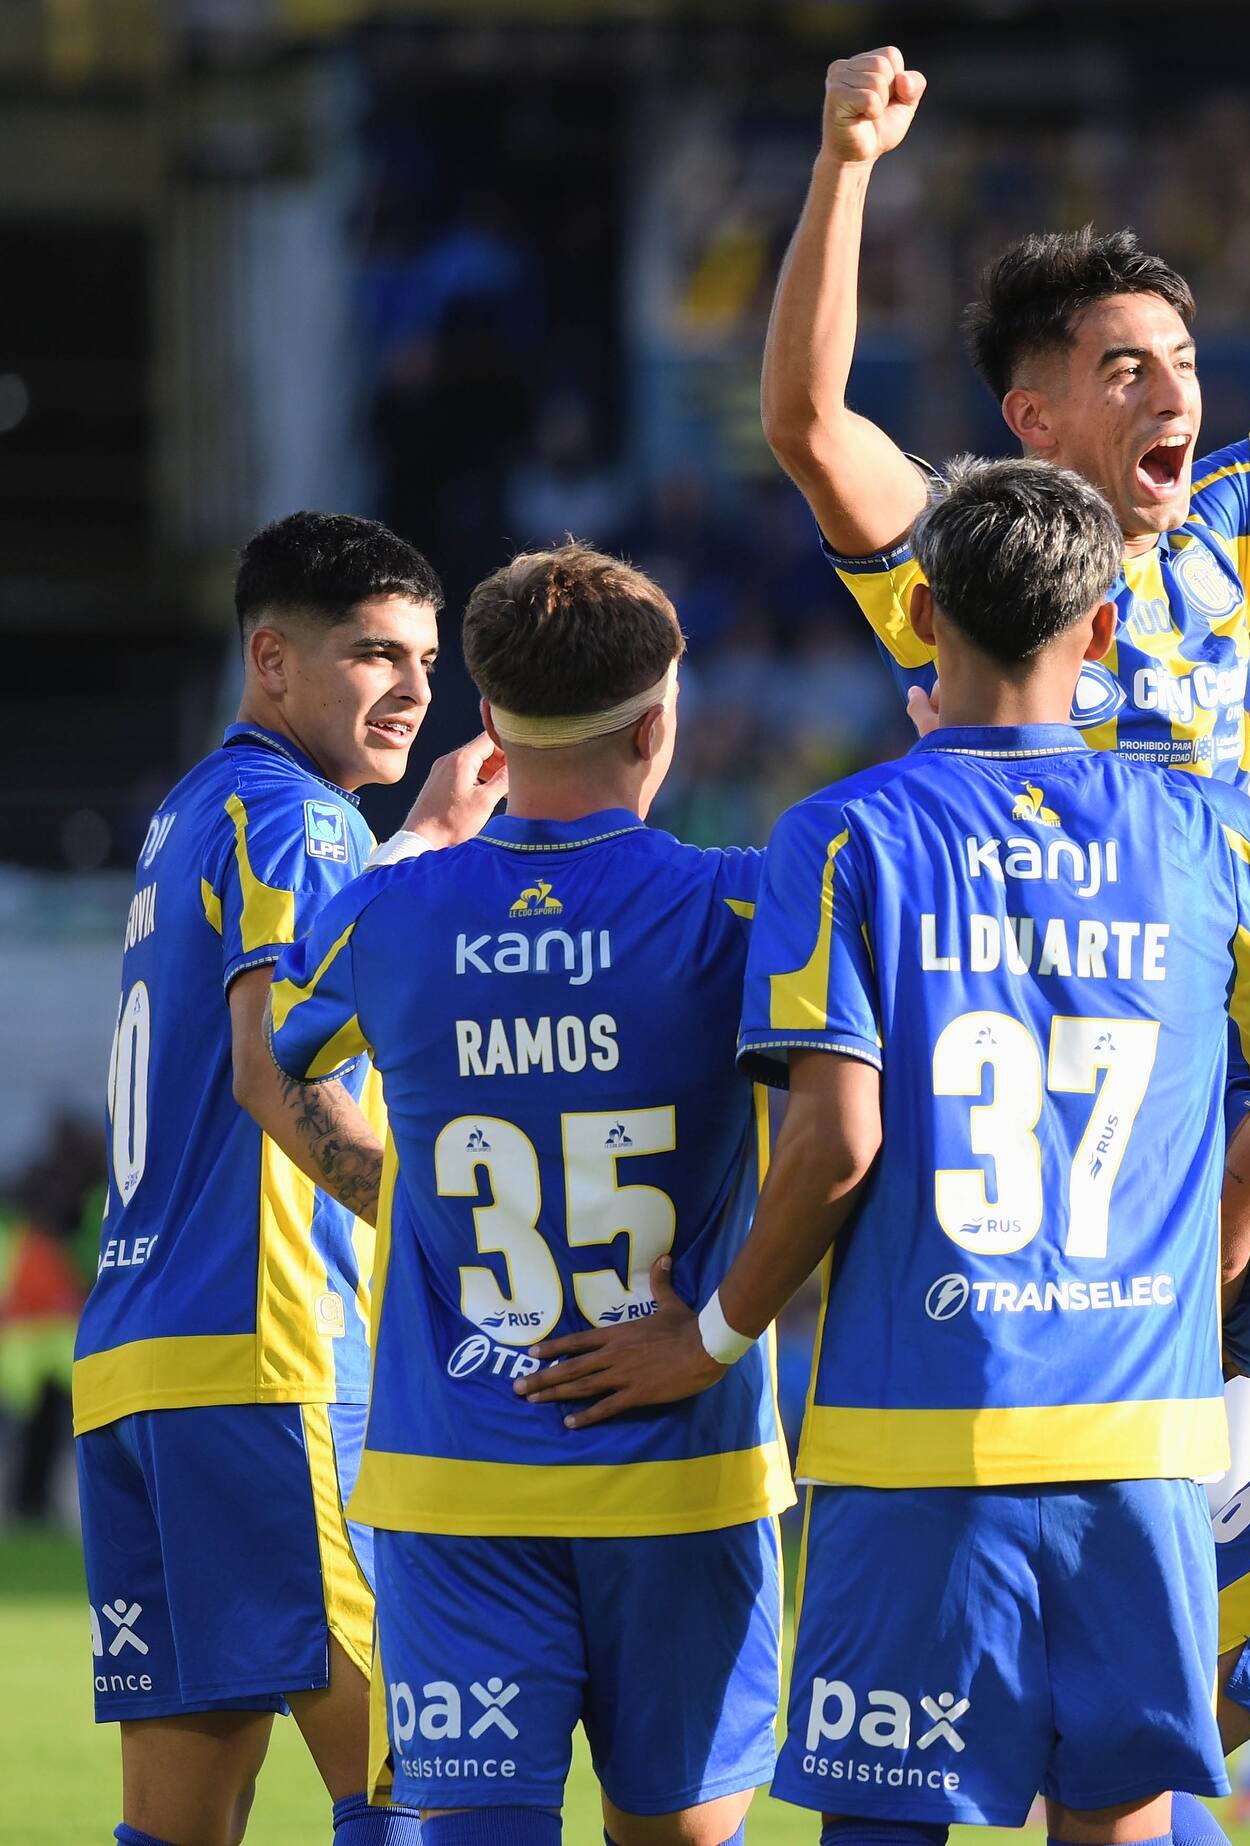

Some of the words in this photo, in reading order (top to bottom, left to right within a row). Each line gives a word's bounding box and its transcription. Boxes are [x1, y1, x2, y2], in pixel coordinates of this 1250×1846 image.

[1119, 740, 1171, 751] PROHIBIDO
[1172, 742, 1192, 751] PARA
[1157, 753, 1170, 763] DE
[1170, 753, 1190, 762] EDAD
[309, 838, 345, 859] LPF
[970, 913, 1169, 981] DUARTE
[455, 1013, 620, 1077] RAMOS
[107, 980, 150, 1209] 0
[932, 1009, 1161, 1259] 37
[1096, 1114, 1119, 1153] RUS
[434, 1104, 677, 1347] 35
[987, 1218, 1022, 1233] RUS
[972, 1274, 1175, 1313] TRANSELEC
[508, 1312, 542, 1327] RUS
[492, 1346, 559, 1379] TR
[389, 1677, 521, 1756] pax
[805, 1676, 971, 1753] pax
[802, 1754, 960, 1791] assistance
